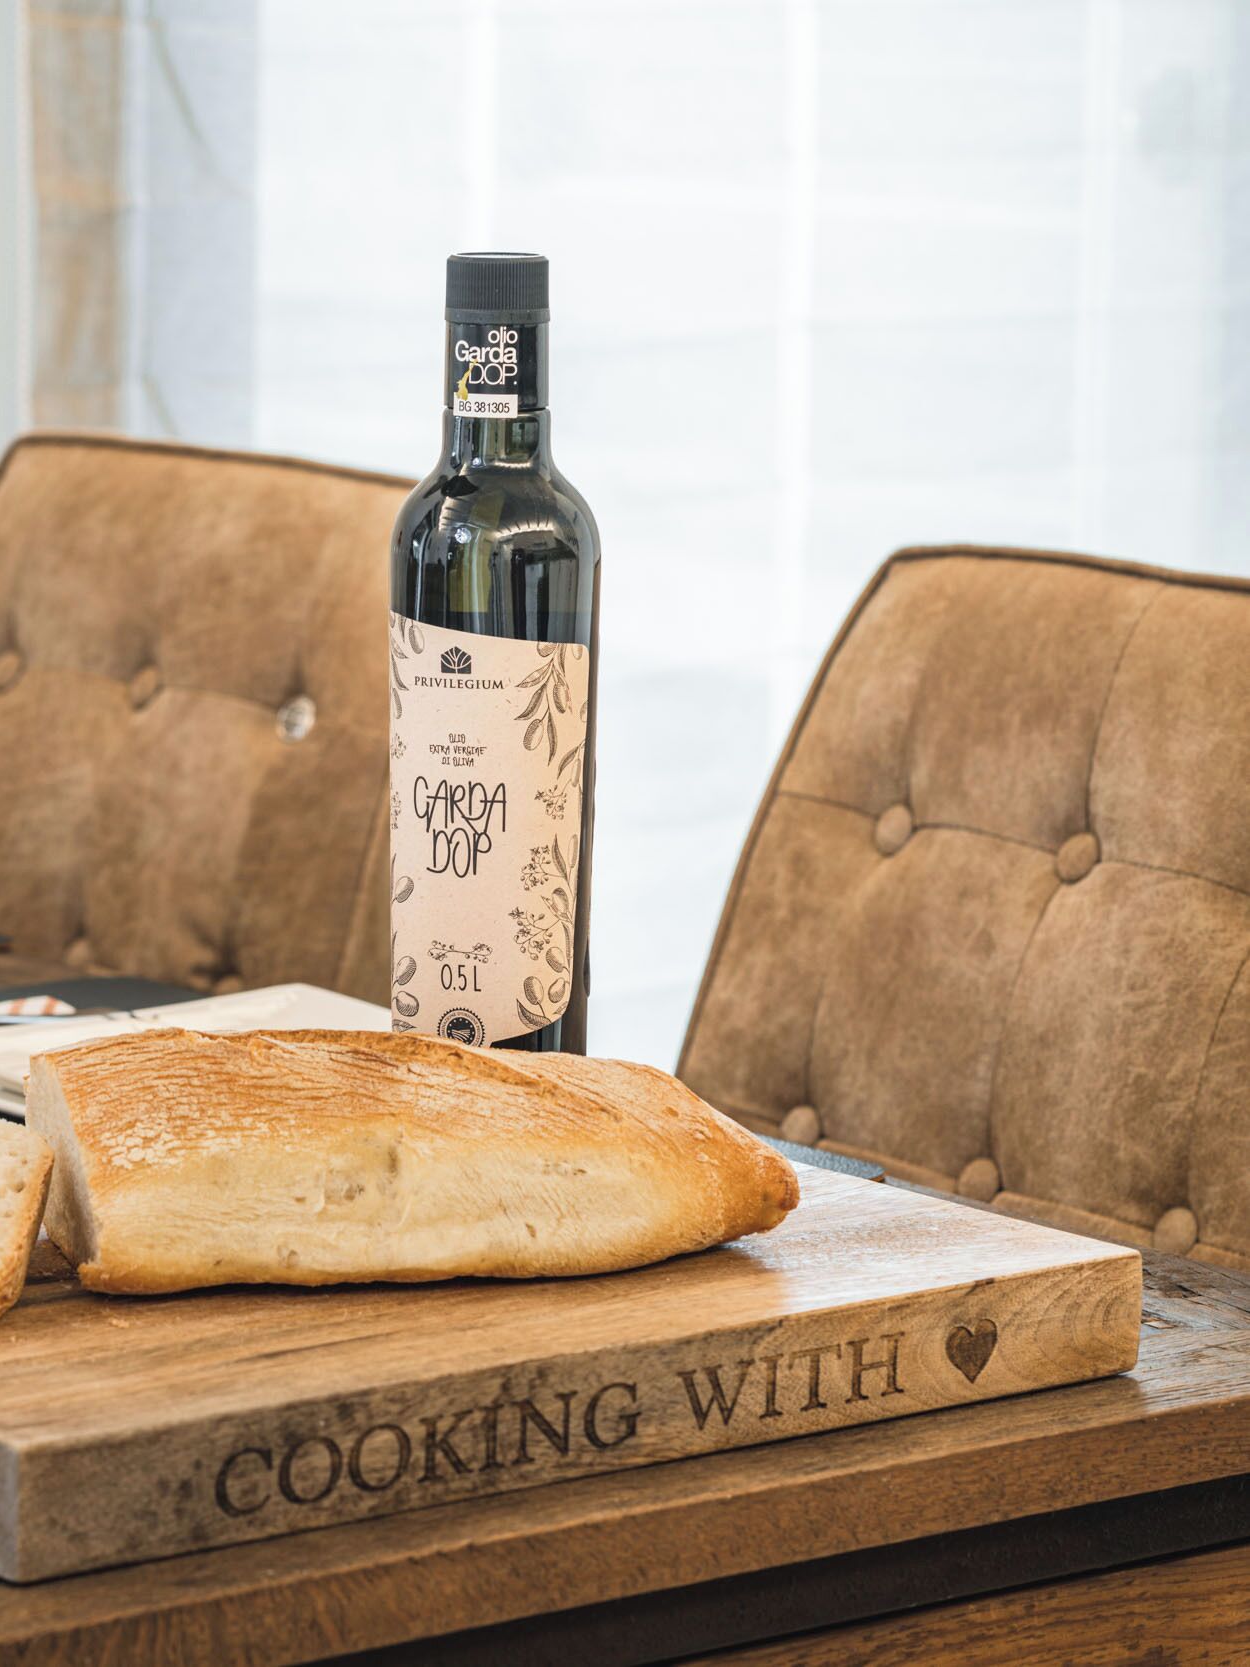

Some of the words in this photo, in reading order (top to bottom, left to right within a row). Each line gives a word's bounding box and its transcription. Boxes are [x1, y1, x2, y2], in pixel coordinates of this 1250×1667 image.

[488, 326, 518, 344] olio
[455, 340, 517, 363] Garda
[458, 401, 472, 413] BG
[474, 402, 510, 413] 381305
[414, 676, 504, 690] PRIVILEGIUM
[429, 744, 450, 755] EXTRA
[453, 745, 487, 757] VERGINE
[452, 756, 474, 767] OLIVA
[414, 776, 507, 834] GARDA
[426, 828, 492, 878] DOP
[214, 1381, 639, 1520] COOKING
[676, 1330, 907, 1432] WITH
